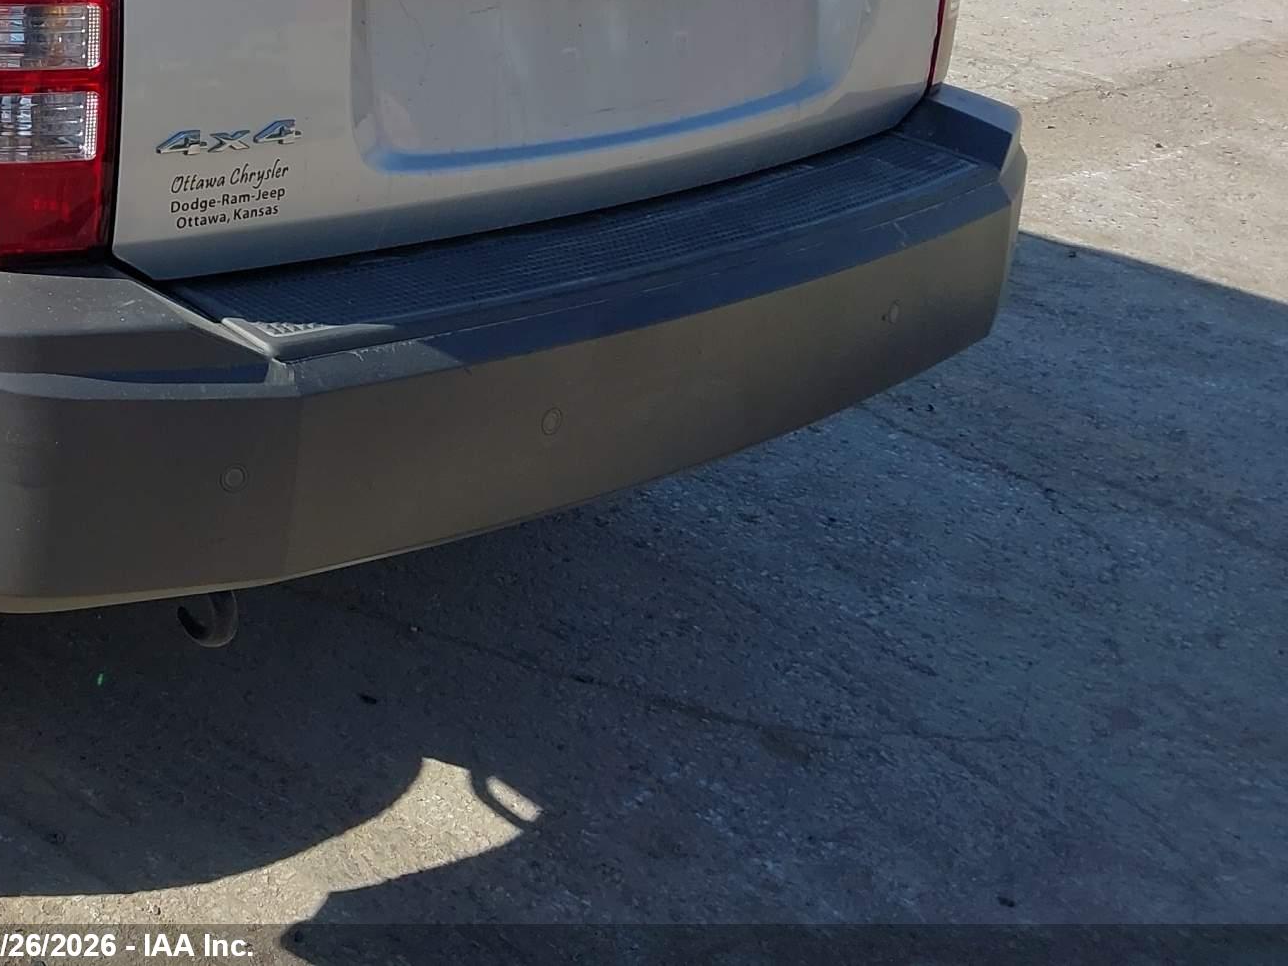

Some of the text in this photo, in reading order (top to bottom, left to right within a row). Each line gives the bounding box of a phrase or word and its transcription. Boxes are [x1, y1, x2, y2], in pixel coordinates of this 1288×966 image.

[170, 158, 290, 194] Ottawa Chrysler
[170, 186, 286, 214] Dodge-Ram-Jeep
[176, 204, 279, 230] Ottawa, Kansas
